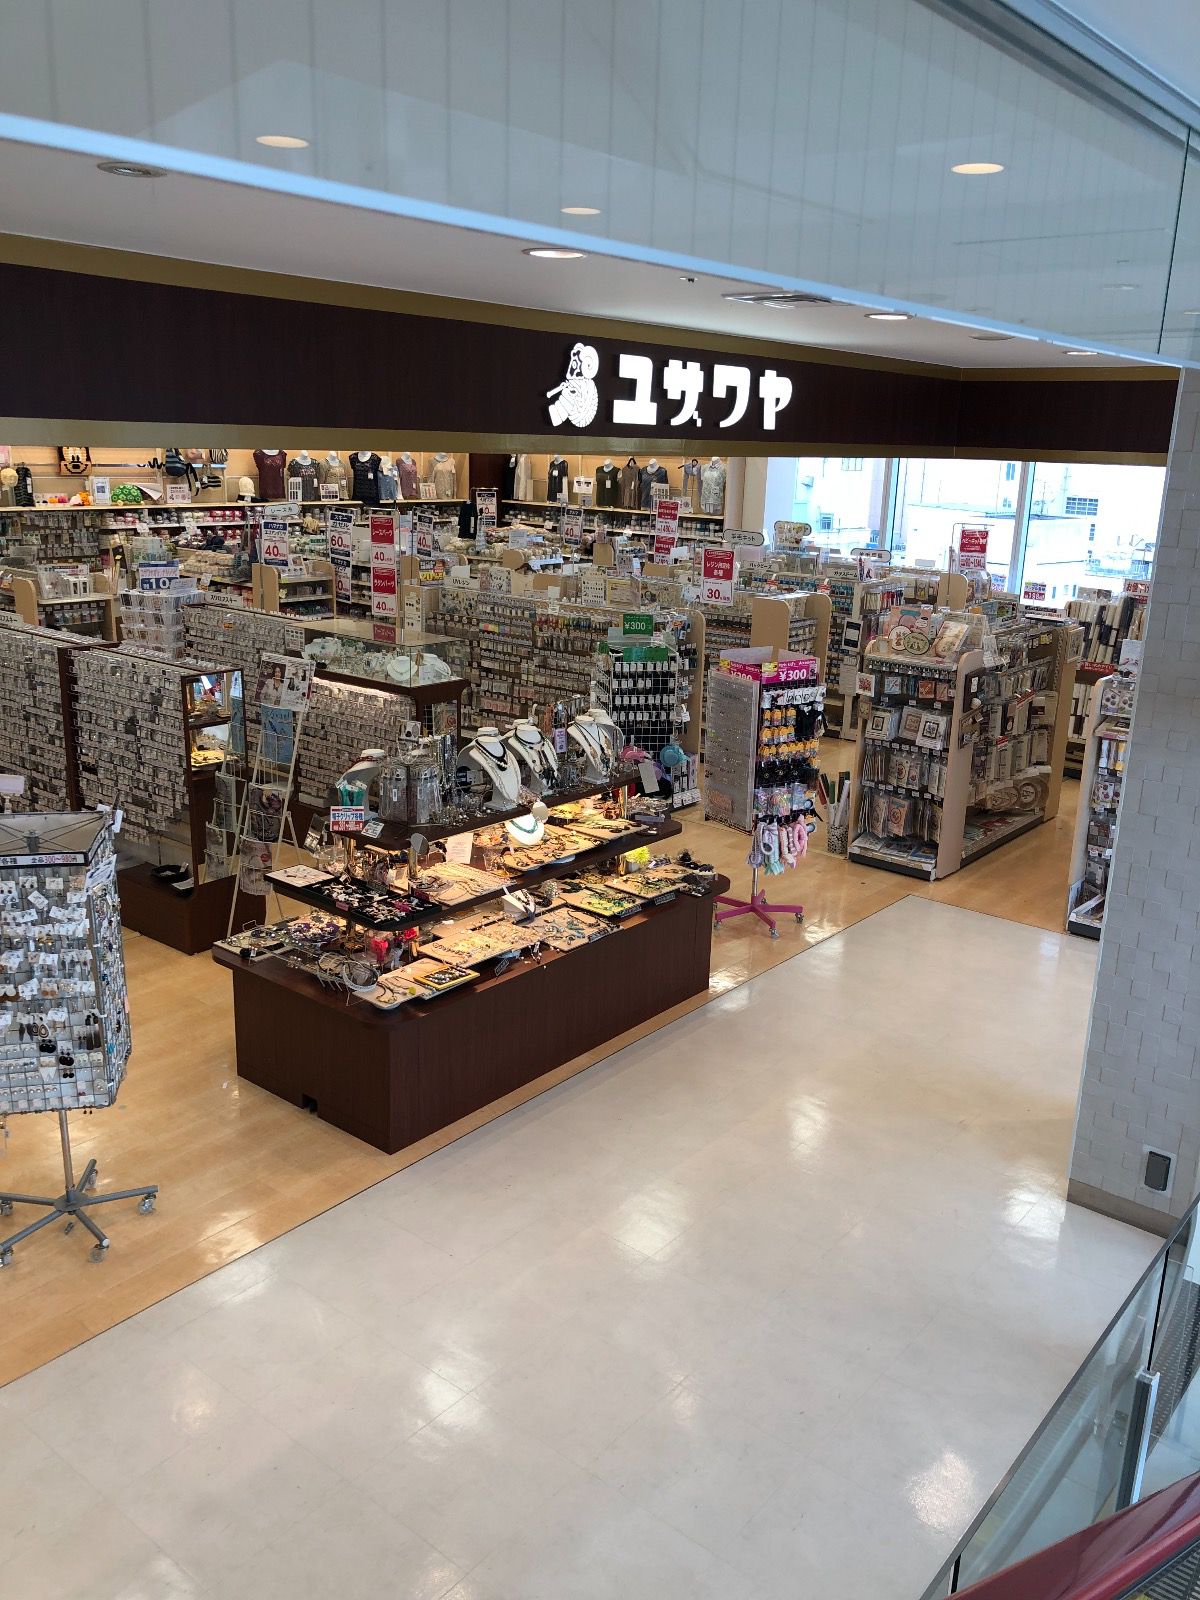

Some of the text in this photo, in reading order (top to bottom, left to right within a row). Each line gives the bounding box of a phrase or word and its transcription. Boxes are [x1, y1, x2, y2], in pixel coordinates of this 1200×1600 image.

[613, 353, 793, 430] ユザワヤ
[624, 621, 646, 631] ¥300
[778, 668, 807, 682] ¥300
